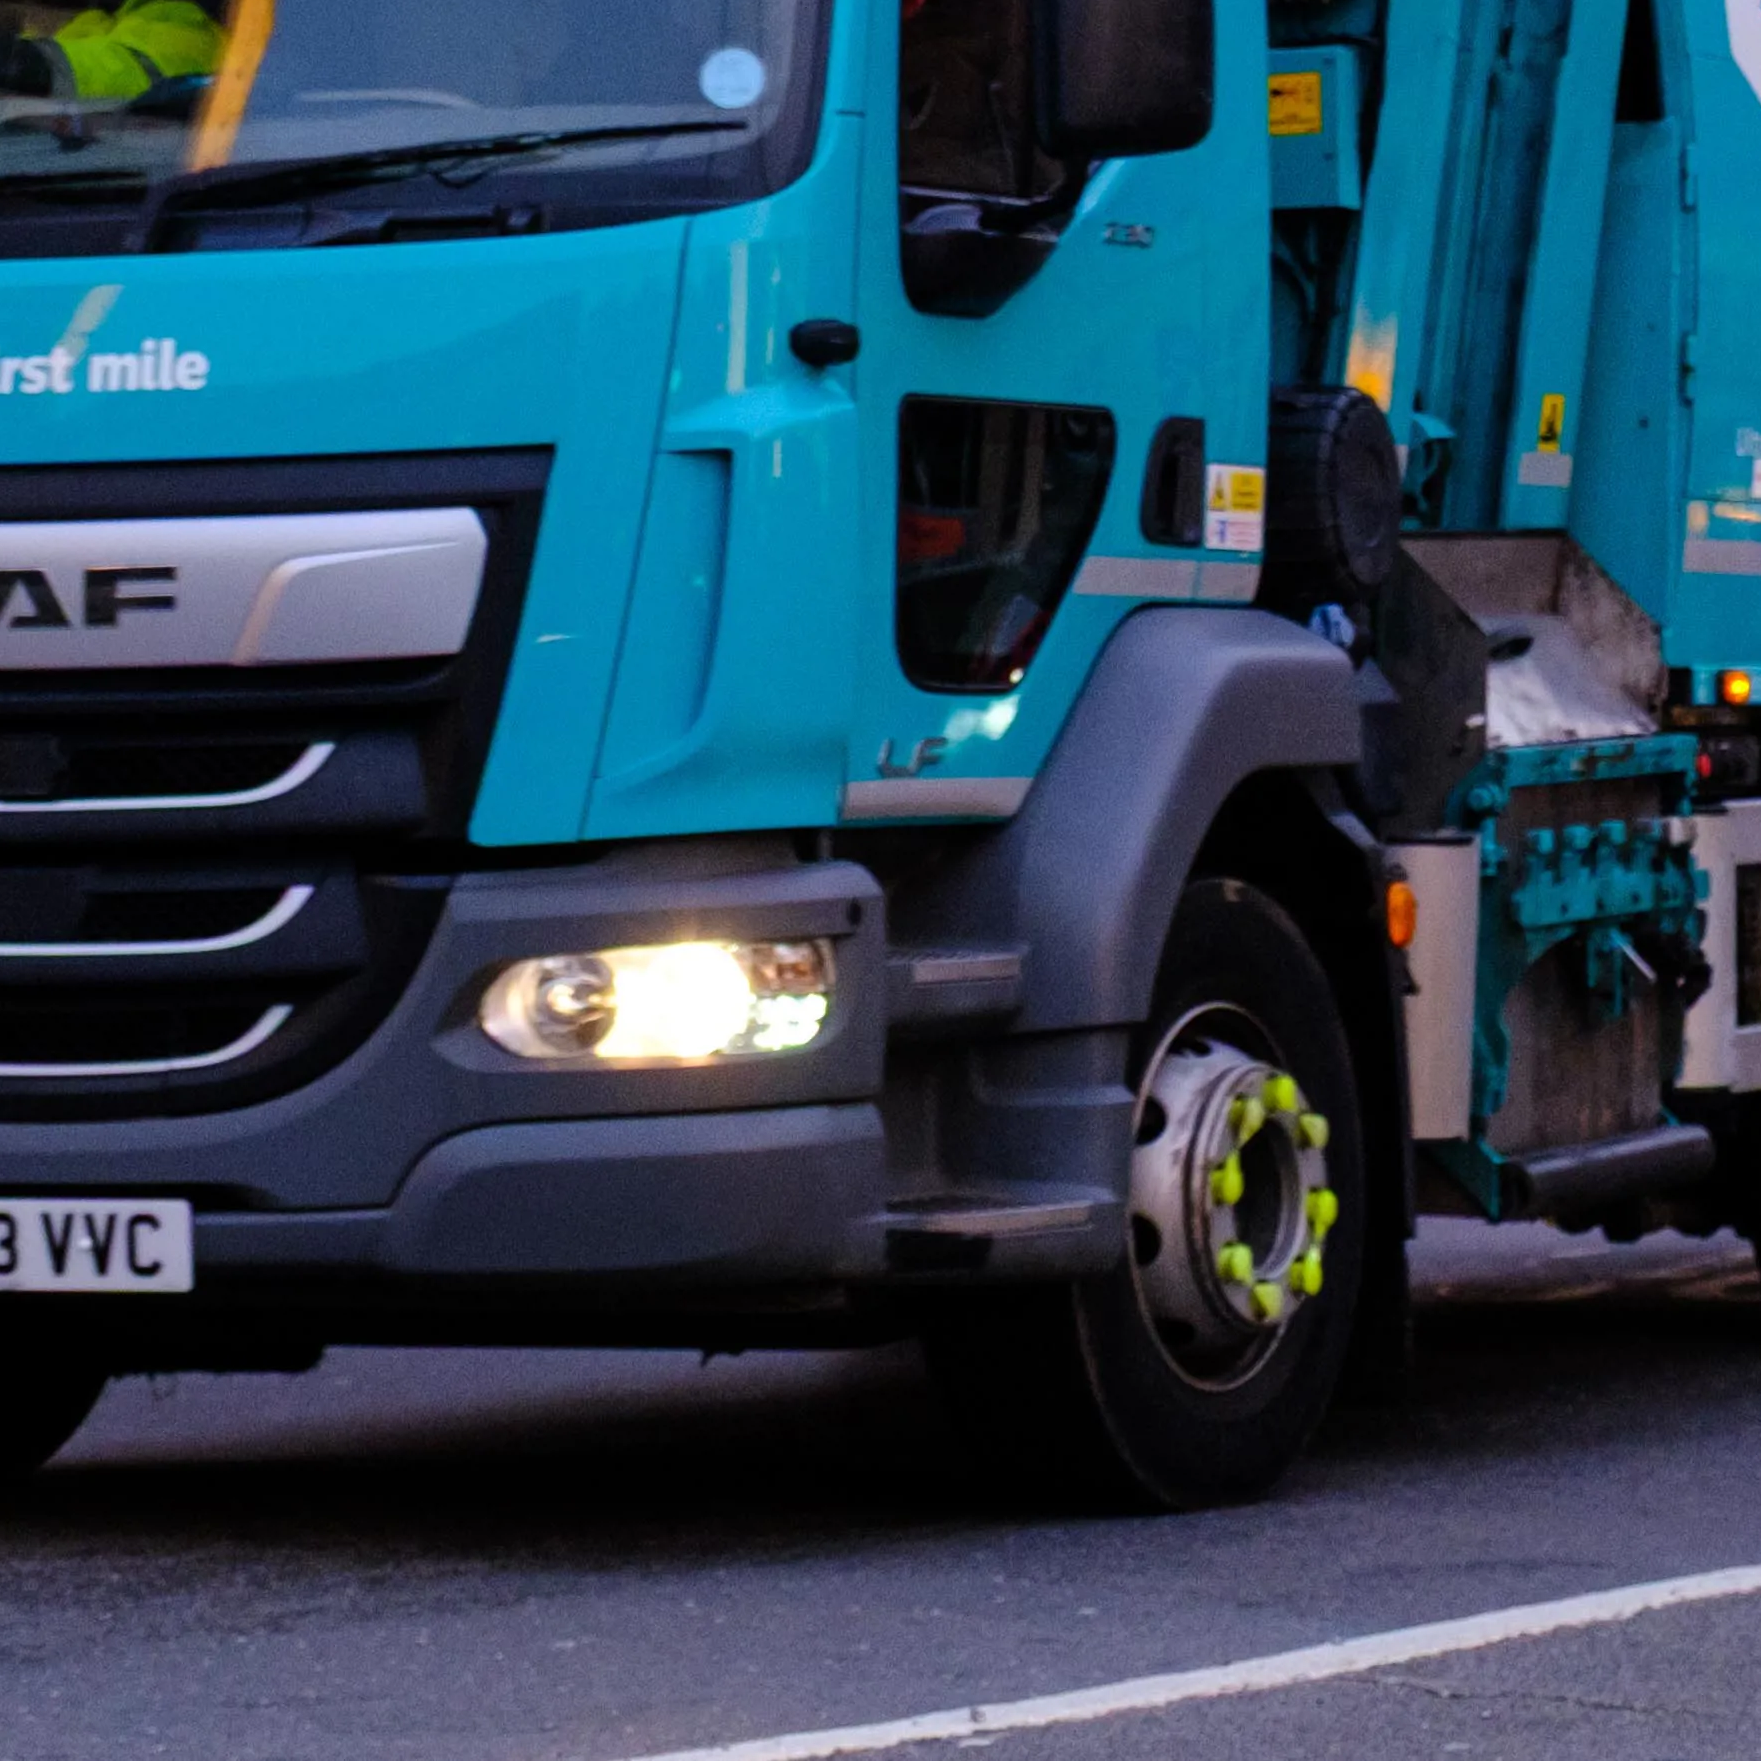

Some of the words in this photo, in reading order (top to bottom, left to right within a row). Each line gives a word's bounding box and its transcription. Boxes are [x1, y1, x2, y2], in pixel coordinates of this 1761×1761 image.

[86, 337, 211, 393] mile
[876, 736, 948, 779] LF
[38, 1212, 164, 1278] VVC
